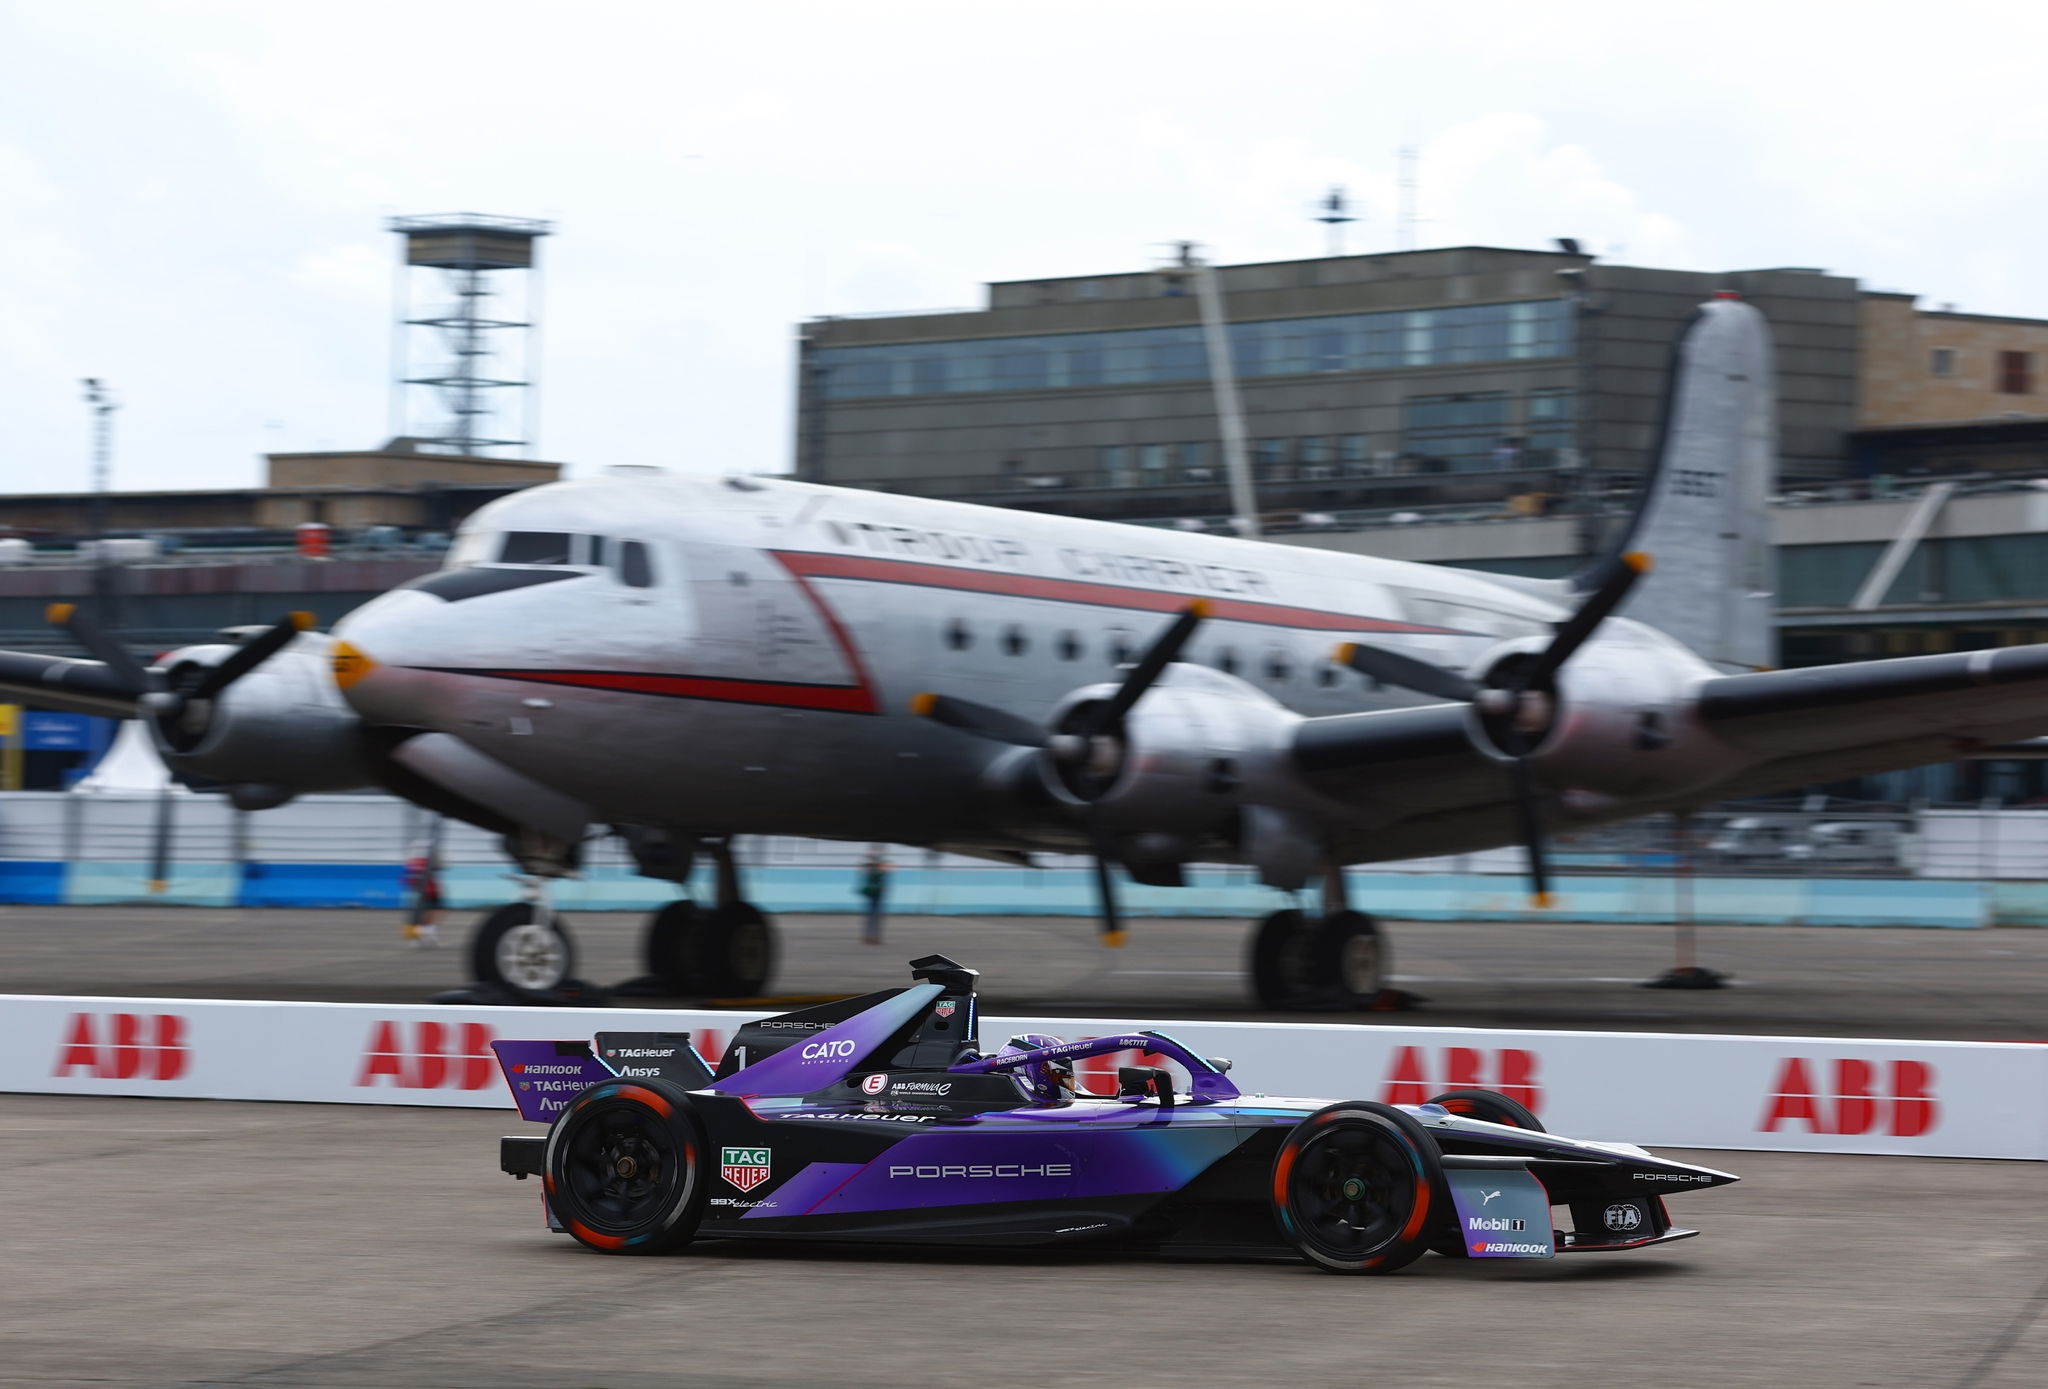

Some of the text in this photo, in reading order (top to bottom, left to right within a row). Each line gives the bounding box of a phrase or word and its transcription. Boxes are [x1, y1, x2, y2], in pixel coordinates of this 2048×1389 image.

[54, 1012, 195, 1081] ABB
[802, 1039, 856, 1060] CATO
[1119, 1038, 1149, 1047] LOCTITE
[355, 1020, 498, 1091] ABB
[734, 1046, 746, 1072] 1
[996, 1054, 1028, 1066] RACEBORN
[620, 1065, 661, 1077] Ansys
[869, 1076, 881, 1089] E
[1378, 1046, 1546, 1118] ABB
[1760, 1057, 1940, 1137] ABB
[726, 1150, 766, 1164] TAG
[724, 1167, 767, 1189] HEUER
[889, 1164, 1072, 1178] PORSCHE
[1632, 1173, 1713, 1183] PORSCHE
[1469, 1217, 1525, 1231] Mobil 1
